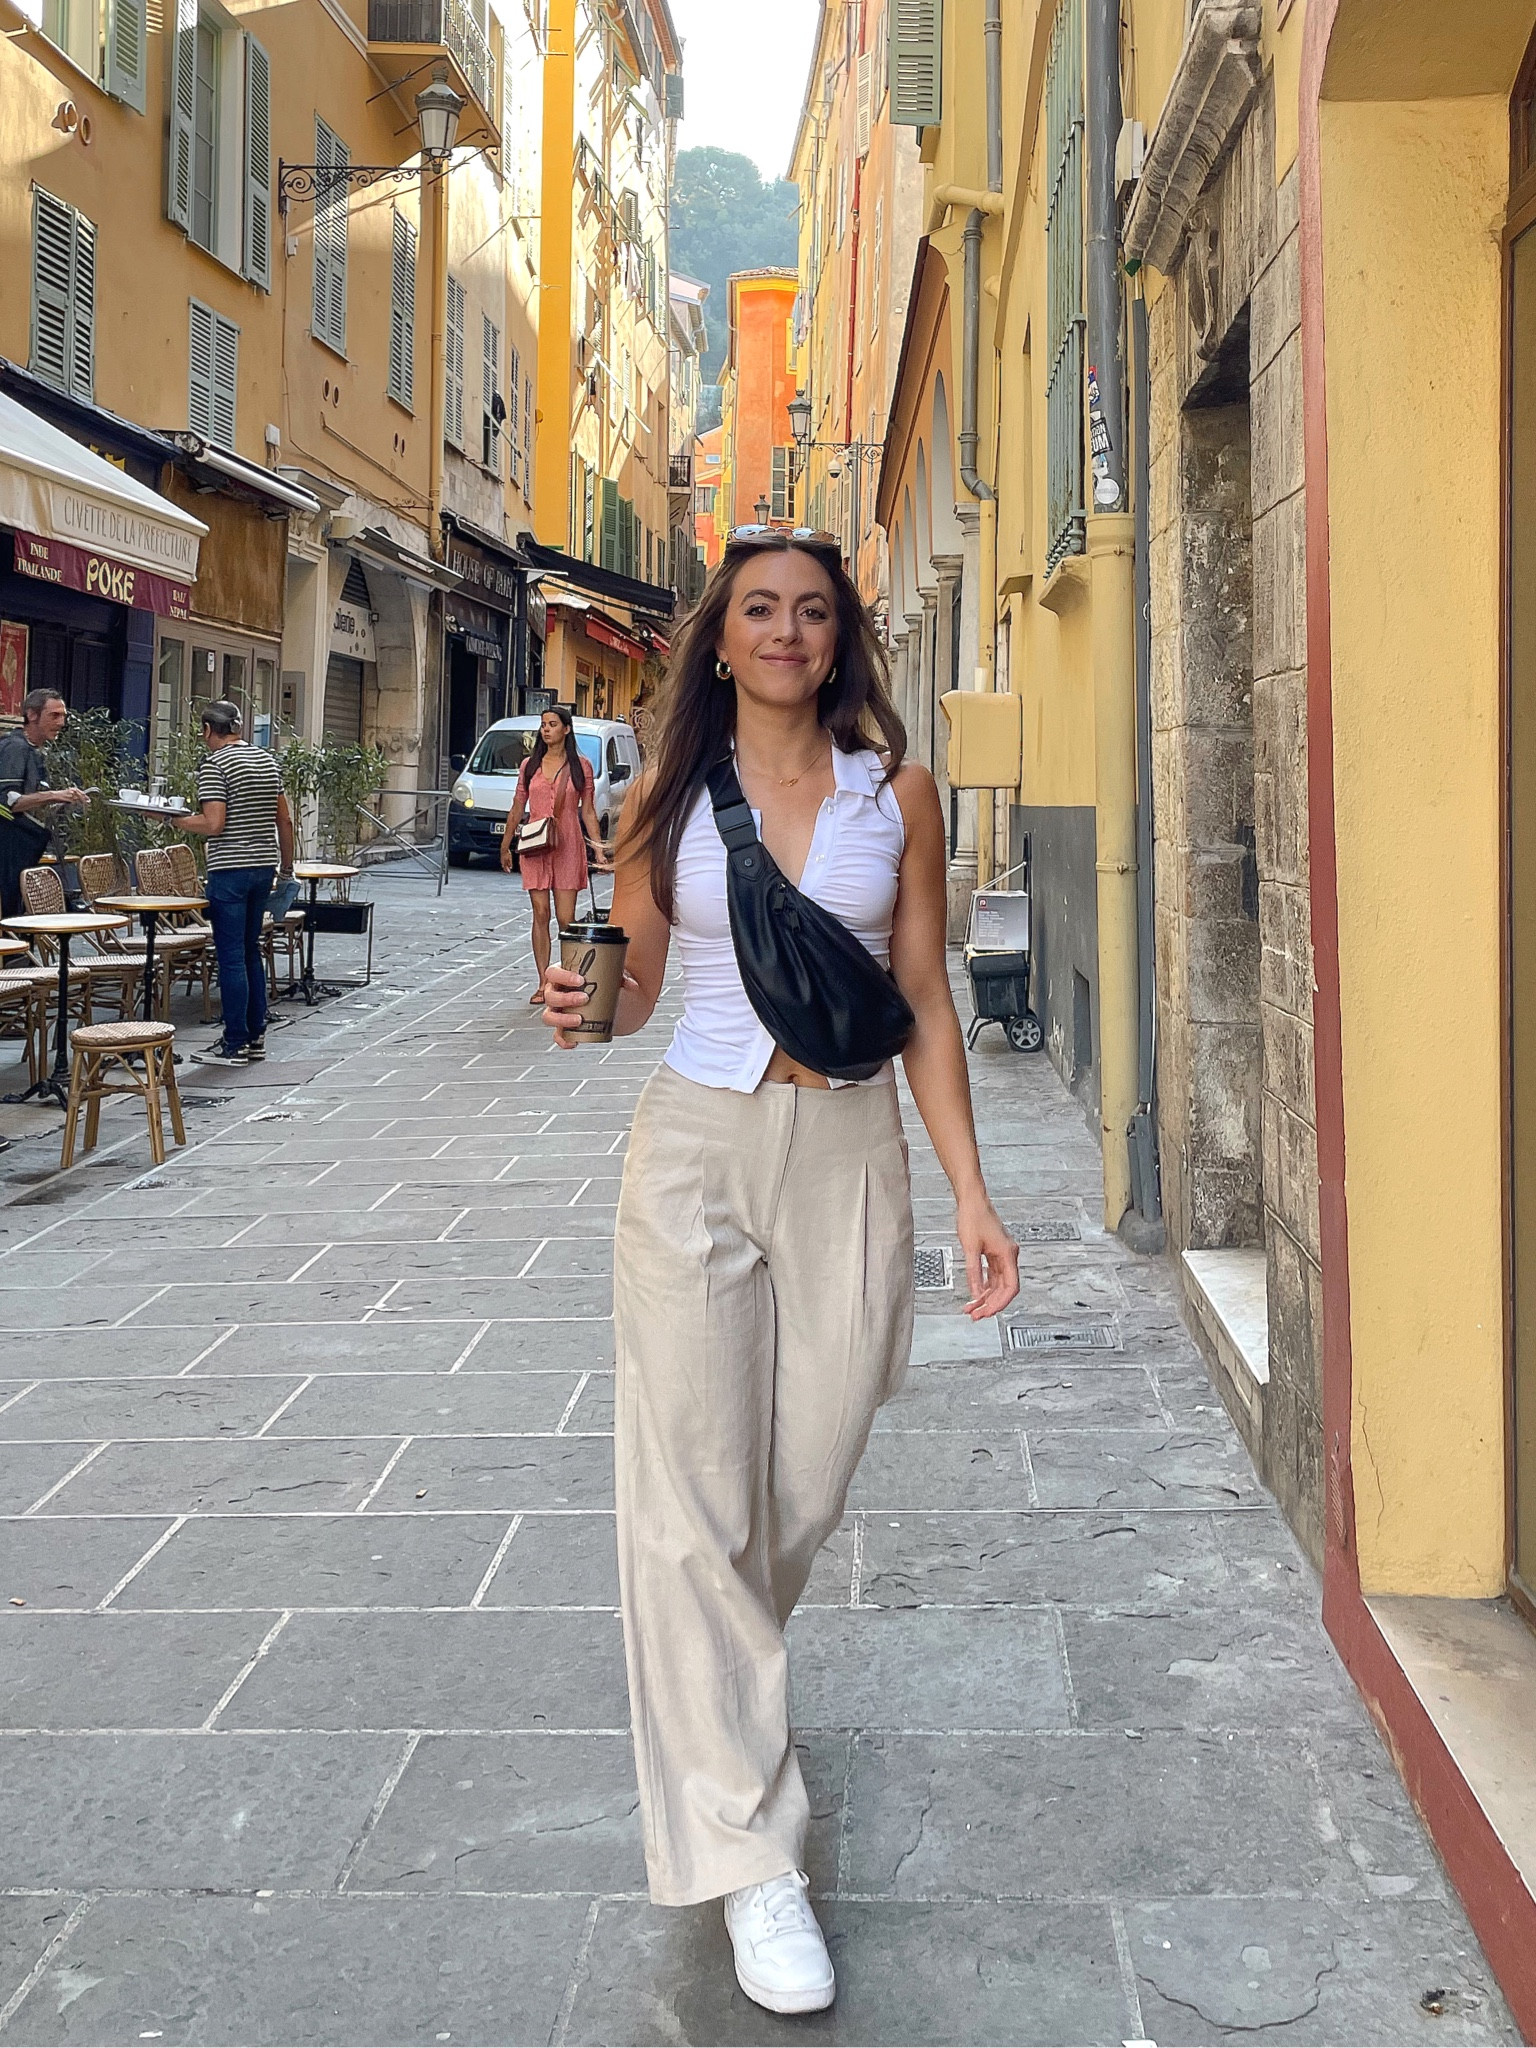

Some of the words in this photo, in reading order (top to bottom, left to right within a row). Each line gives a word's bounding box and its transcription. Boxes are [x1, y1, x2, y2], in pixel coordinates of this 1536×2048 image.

[65, 495, 107, 538] CIVETTE
[110, 511, 121, 542] DE
[124, 516, 135, 546] LA
[30, 542, 49, 560] INDE
[453, 549, 480, 585] HOUSE
[86, 558, 135, 605] POKE
